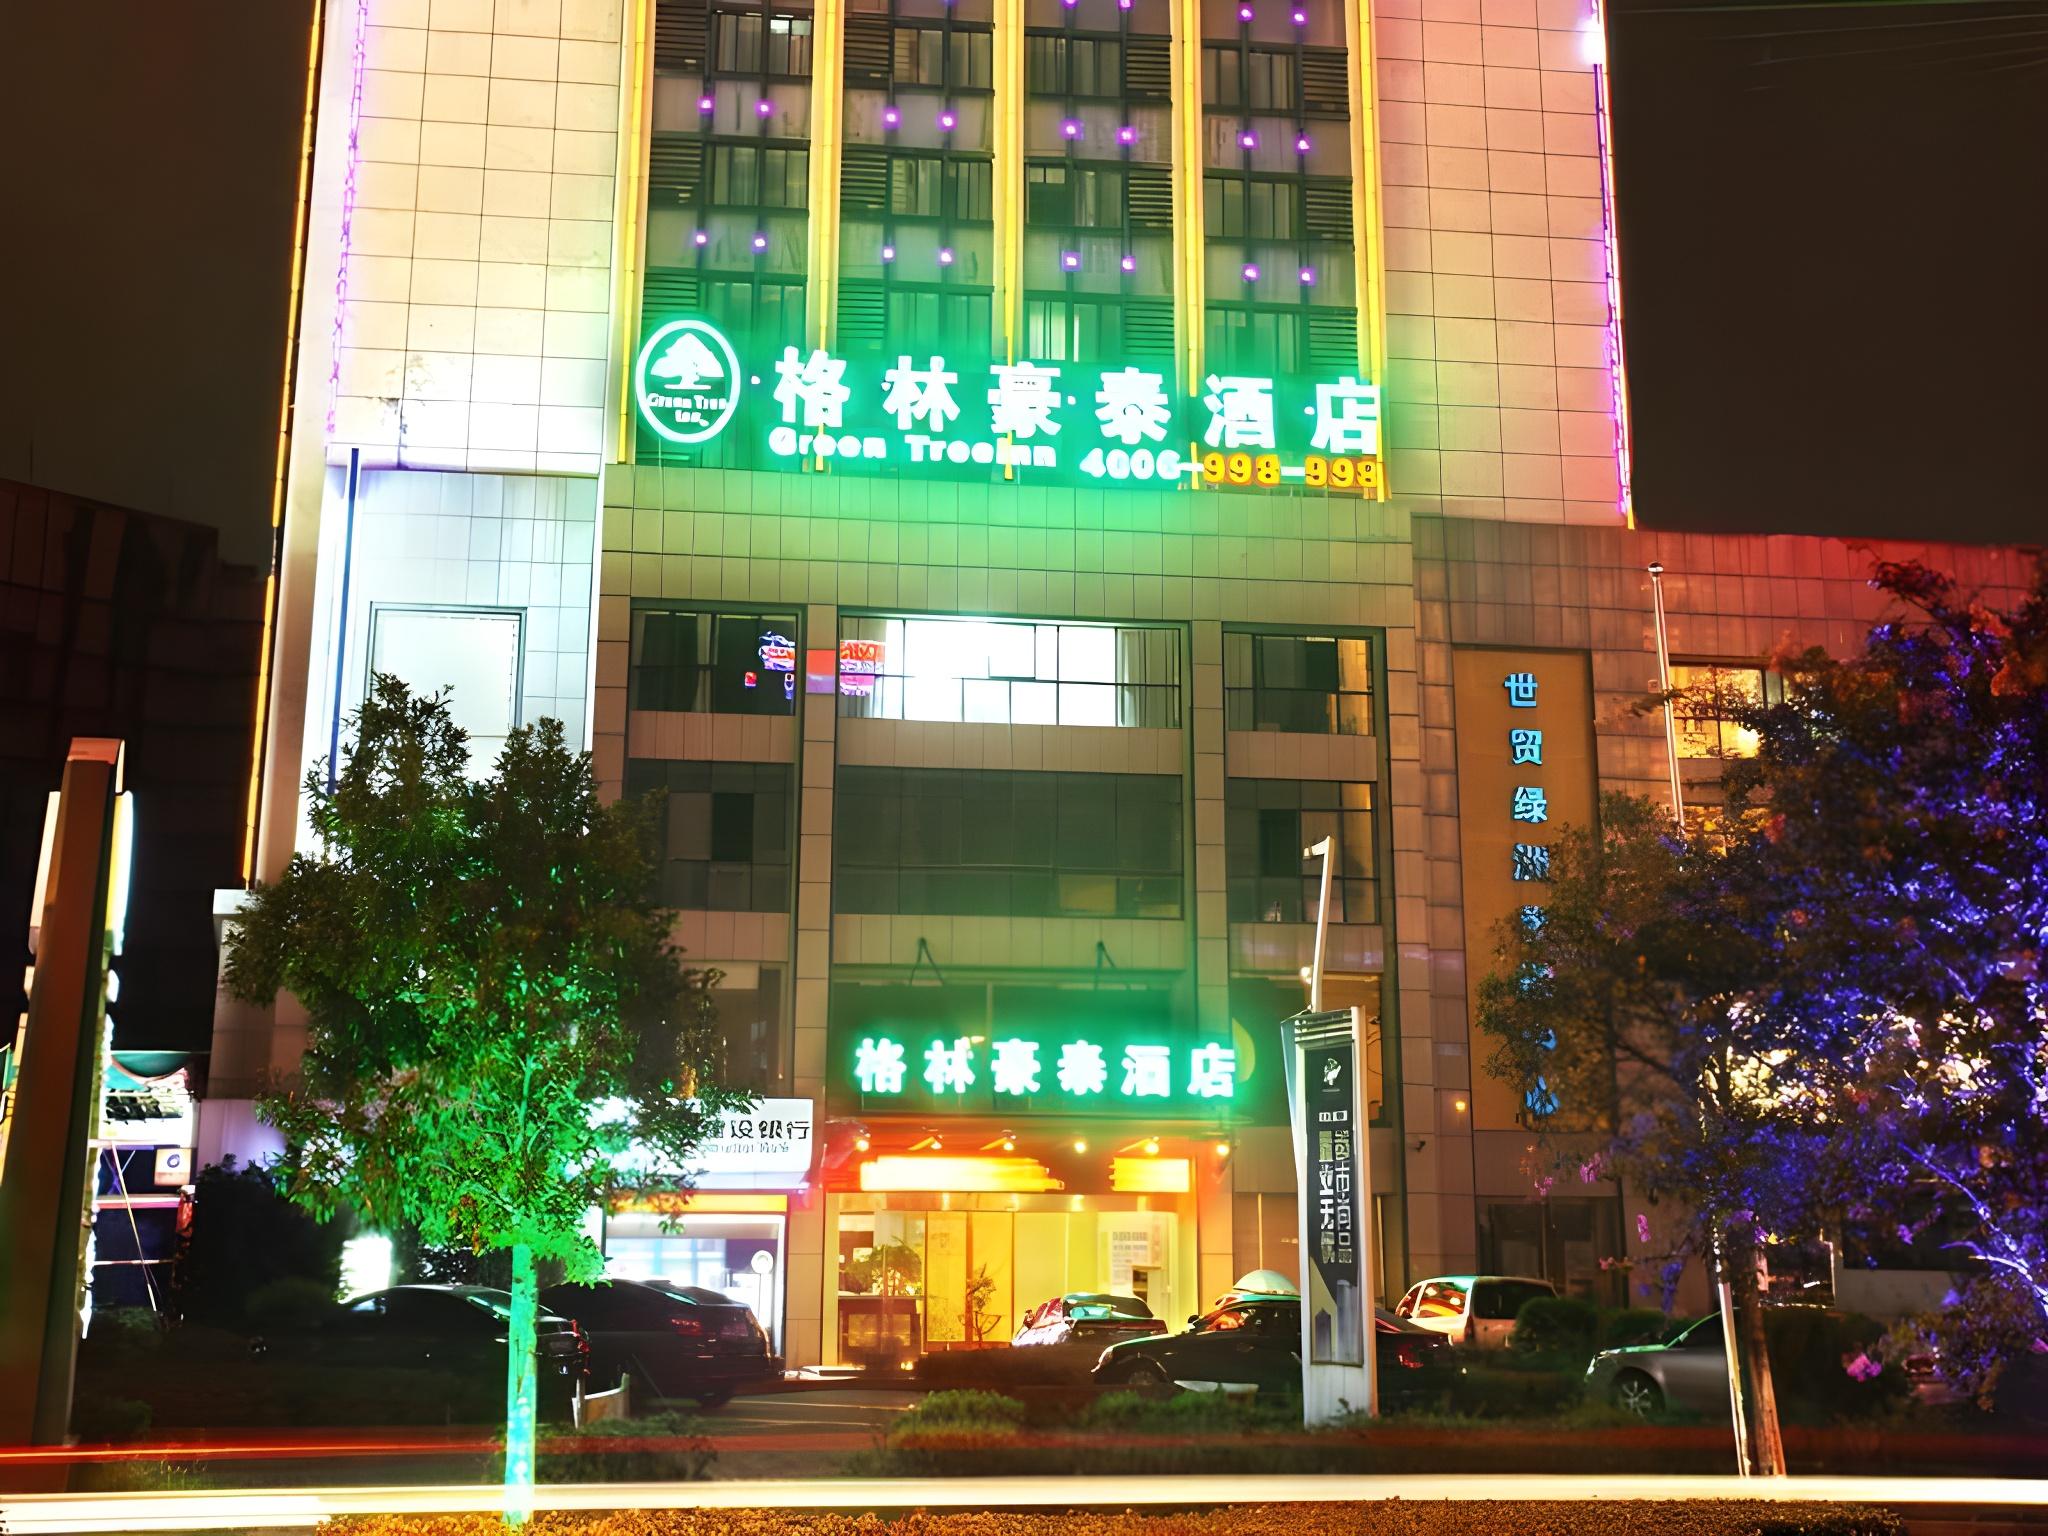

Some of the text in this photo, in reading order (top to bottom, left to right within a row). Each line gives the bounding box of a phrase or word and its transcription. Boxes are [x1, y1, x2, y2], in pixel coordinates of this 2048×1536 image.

[773, 345, 1381, 455] 格林豪泰酒店
[768, 426, 887, 459] Green
[854, 1037, 1237, 1098] 格林豪泰酒店
